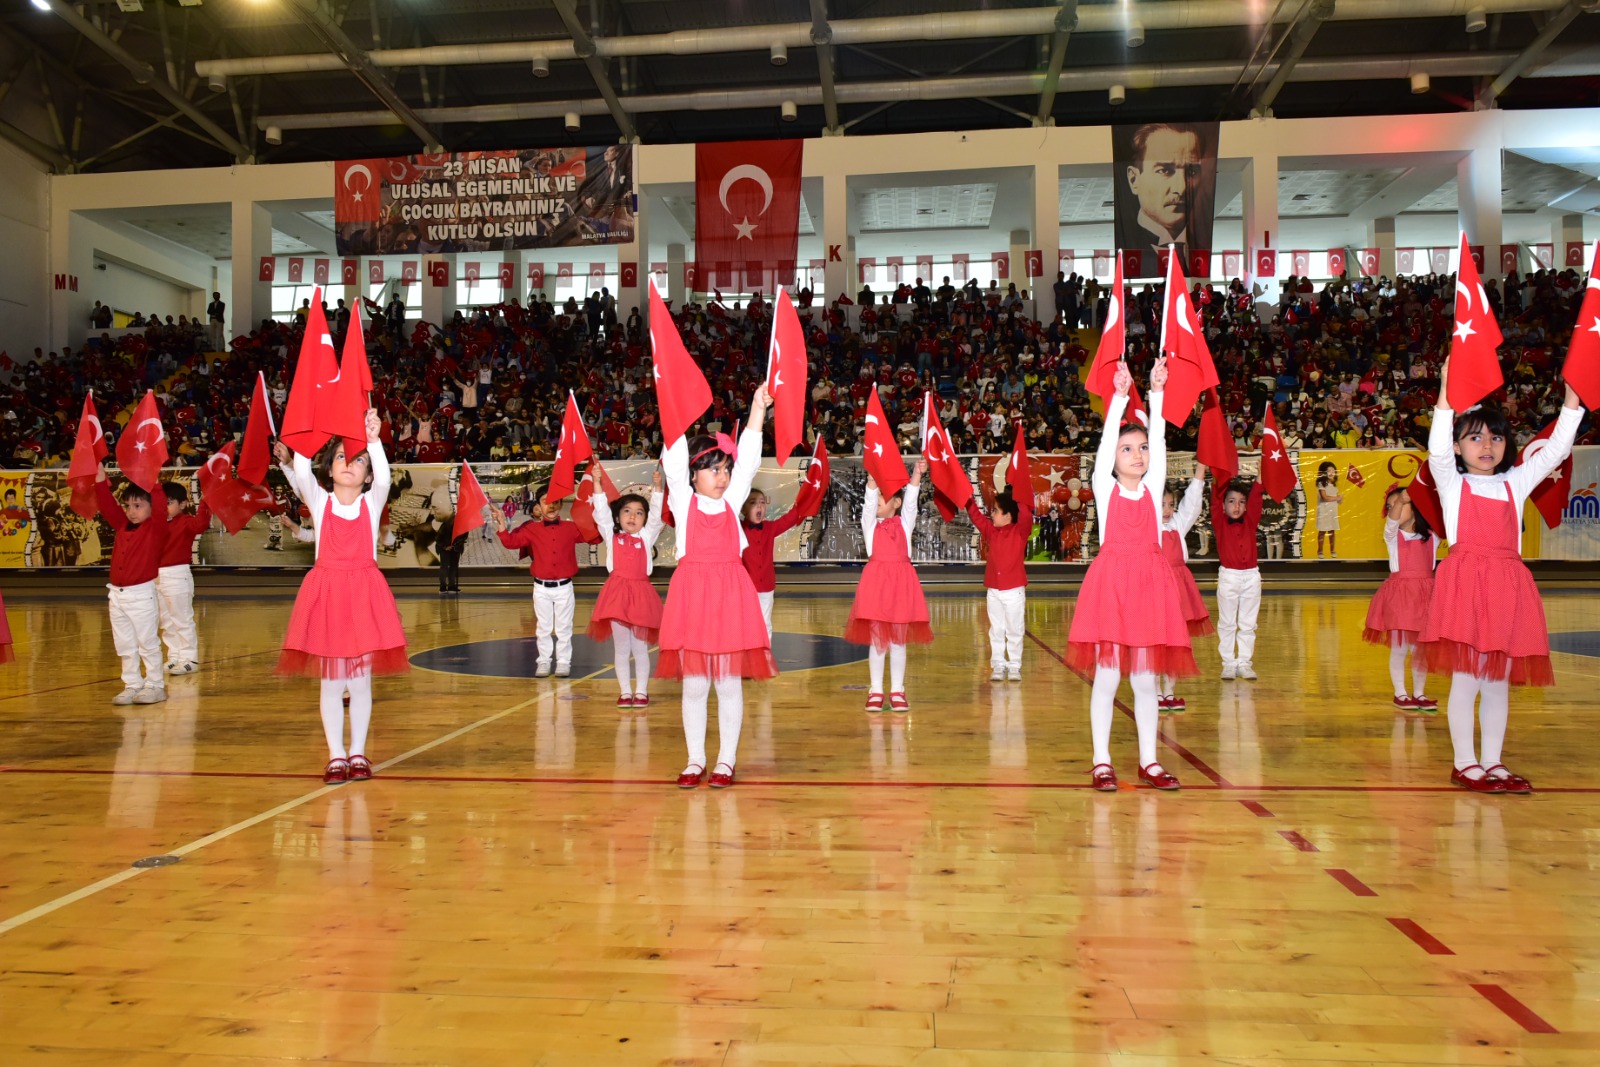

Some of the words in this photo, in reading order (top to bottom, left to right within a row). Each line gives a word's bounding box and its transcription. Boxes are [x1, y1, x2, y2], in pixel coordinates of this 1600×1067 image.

[443, 161, 464, 177] 23
[468, 155, 521, 175] NİSAN
[391, 182, 452, 199] ULUSAL
[456, 176, 551, 197] EGEMENLİK
[554, 175, 577, 192] VE
[401, 202, 456, 225] ÇOCUK
[460, 198, 565, 218] BAYRAMINIZ
[427, 223, 478, 241] KUTLU
[482, 220, 538, 238] OLSUN
[581, 232, 606, 240] MALATYA
[829, 244, 842, 262] K
[55, 274, 66, 290] M
[69, 275, 78, 292] M
